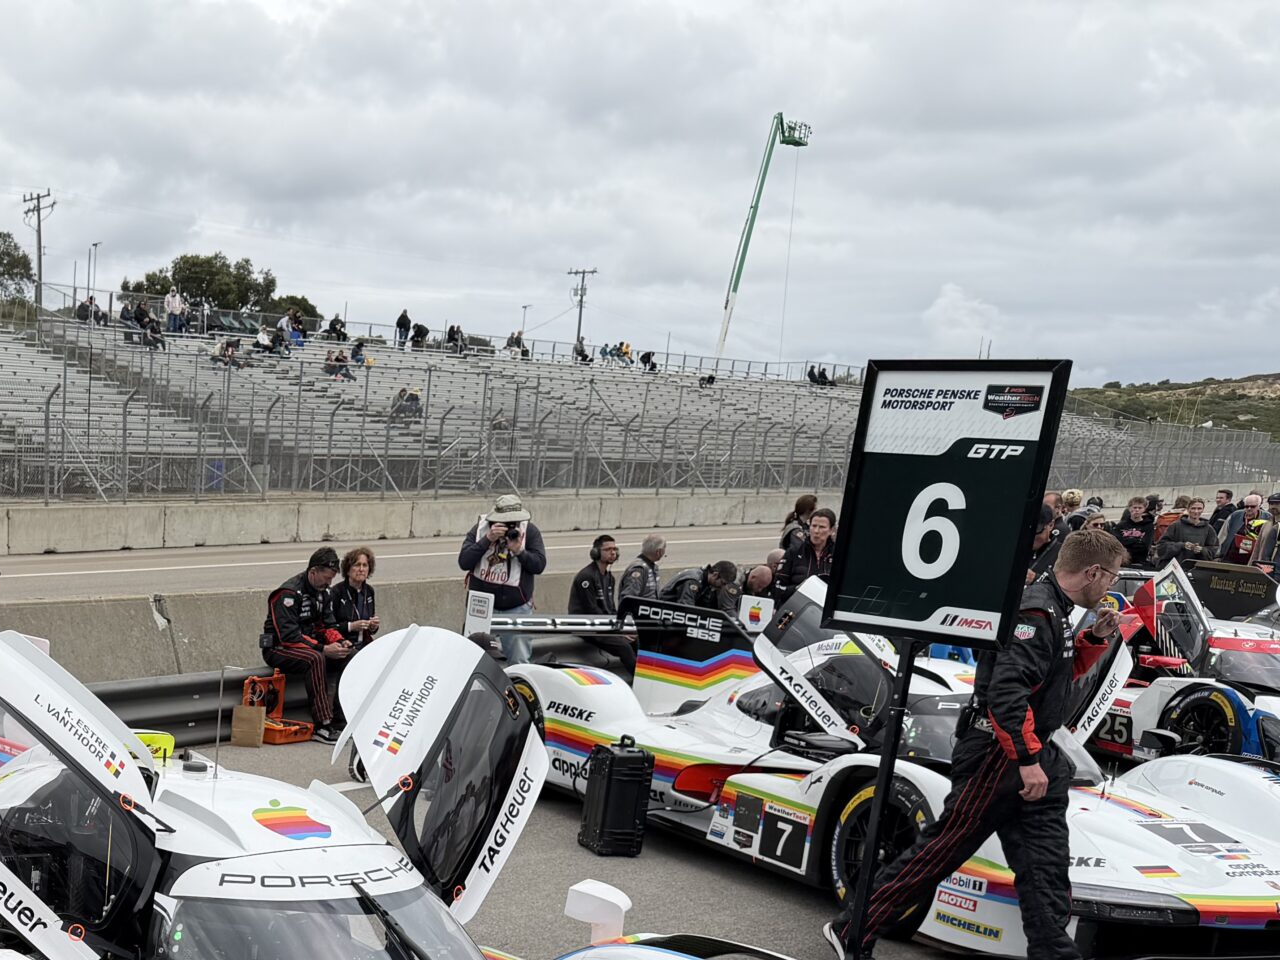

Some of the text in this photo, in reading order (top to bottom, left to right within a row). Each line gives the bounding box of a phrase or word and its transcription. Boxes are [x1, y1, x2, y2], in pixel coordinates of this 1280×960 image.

[883, 388, 982, 400] PORSCHE PENSKE
[987, 394, 1040, 402] WeatherTech
[880, 400, 956, 412] MOTORSPORT
[967, 443, 1025, 459] GTP
[902, 482, 966, 580] 6
[1210, 575, 1268, 598] Mustang Sampling
[638, 605, 723, 631] PORSCHE
[957, 617, 993, 631] IMSA
[686, 627, 721, 642] 963
[382, 688, 414, 731] K. ESTRE
[396, 675, 438, 738] L. VANTHOOR
[546, 701, 597, 722] PENSKE
[34, 694, 44, 708] L.
[45, 706, 104, 762] VANTHOOR
[64, 707, 109, 752] K. ESTRE
[1098, 714, 1128, 743] 25
[552, 757, 588, 781] apple
[768, 804, 808, 822] WeatherTech
[776, 821, 793, 856] 7
[1161, 824, 1205, 842] 7
[218, 856, 414, 888] PORSCHE
[939, 892, 975, 910] MOTUL
[936, 911, 1000, 938] MICHELIN
